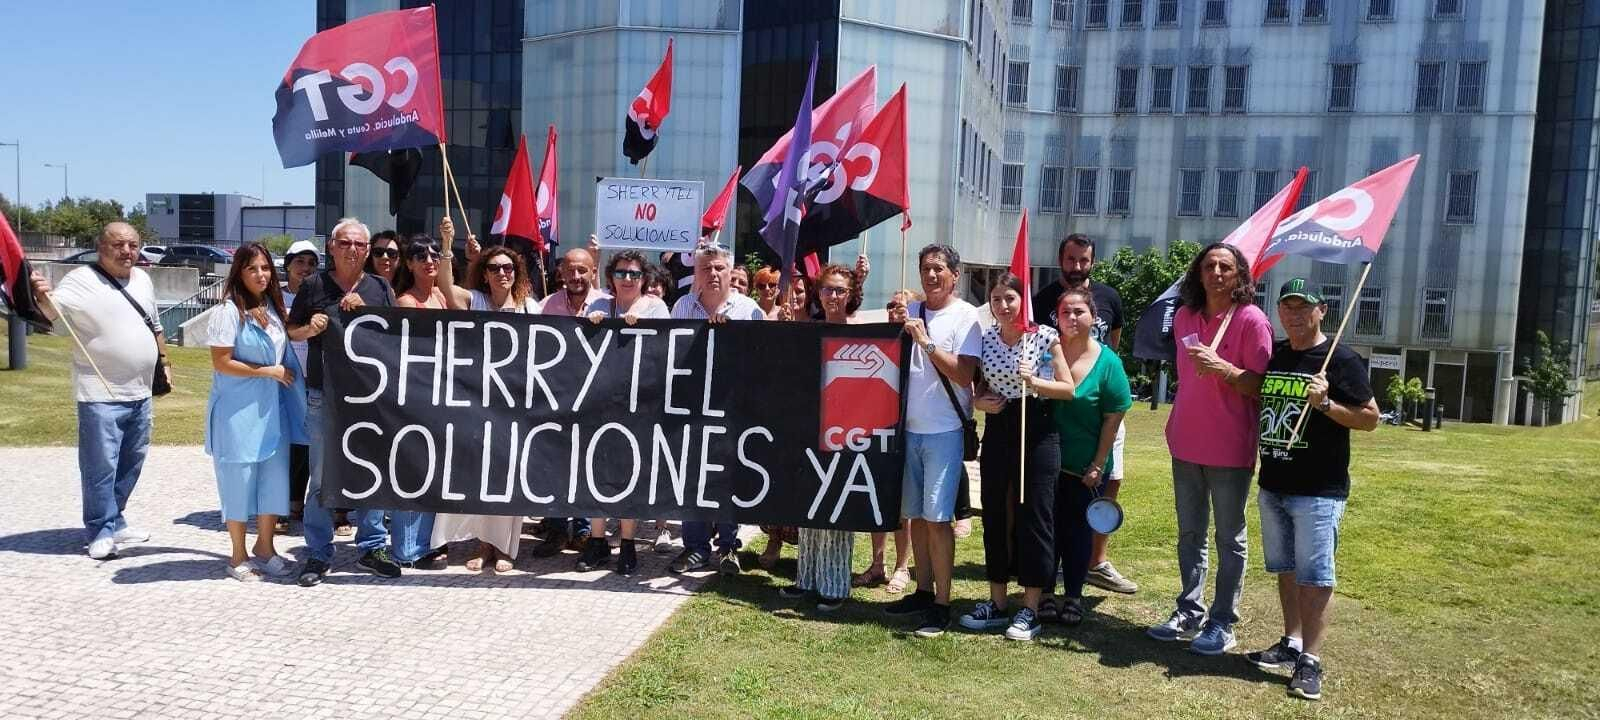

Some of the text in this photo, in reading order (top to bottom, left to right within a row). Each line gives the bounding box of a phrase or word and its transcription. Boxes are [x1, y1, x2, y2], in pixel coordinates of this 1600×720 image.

[634, 203, 657, 221] NO
[605, 225, 689, 243] SOLUCIONES
[343, 315, 725, 417] SHERRYTEL
[824, 426, 896, 453] CGT
[341, 422, 883, 526] SOLUCIONES YA
